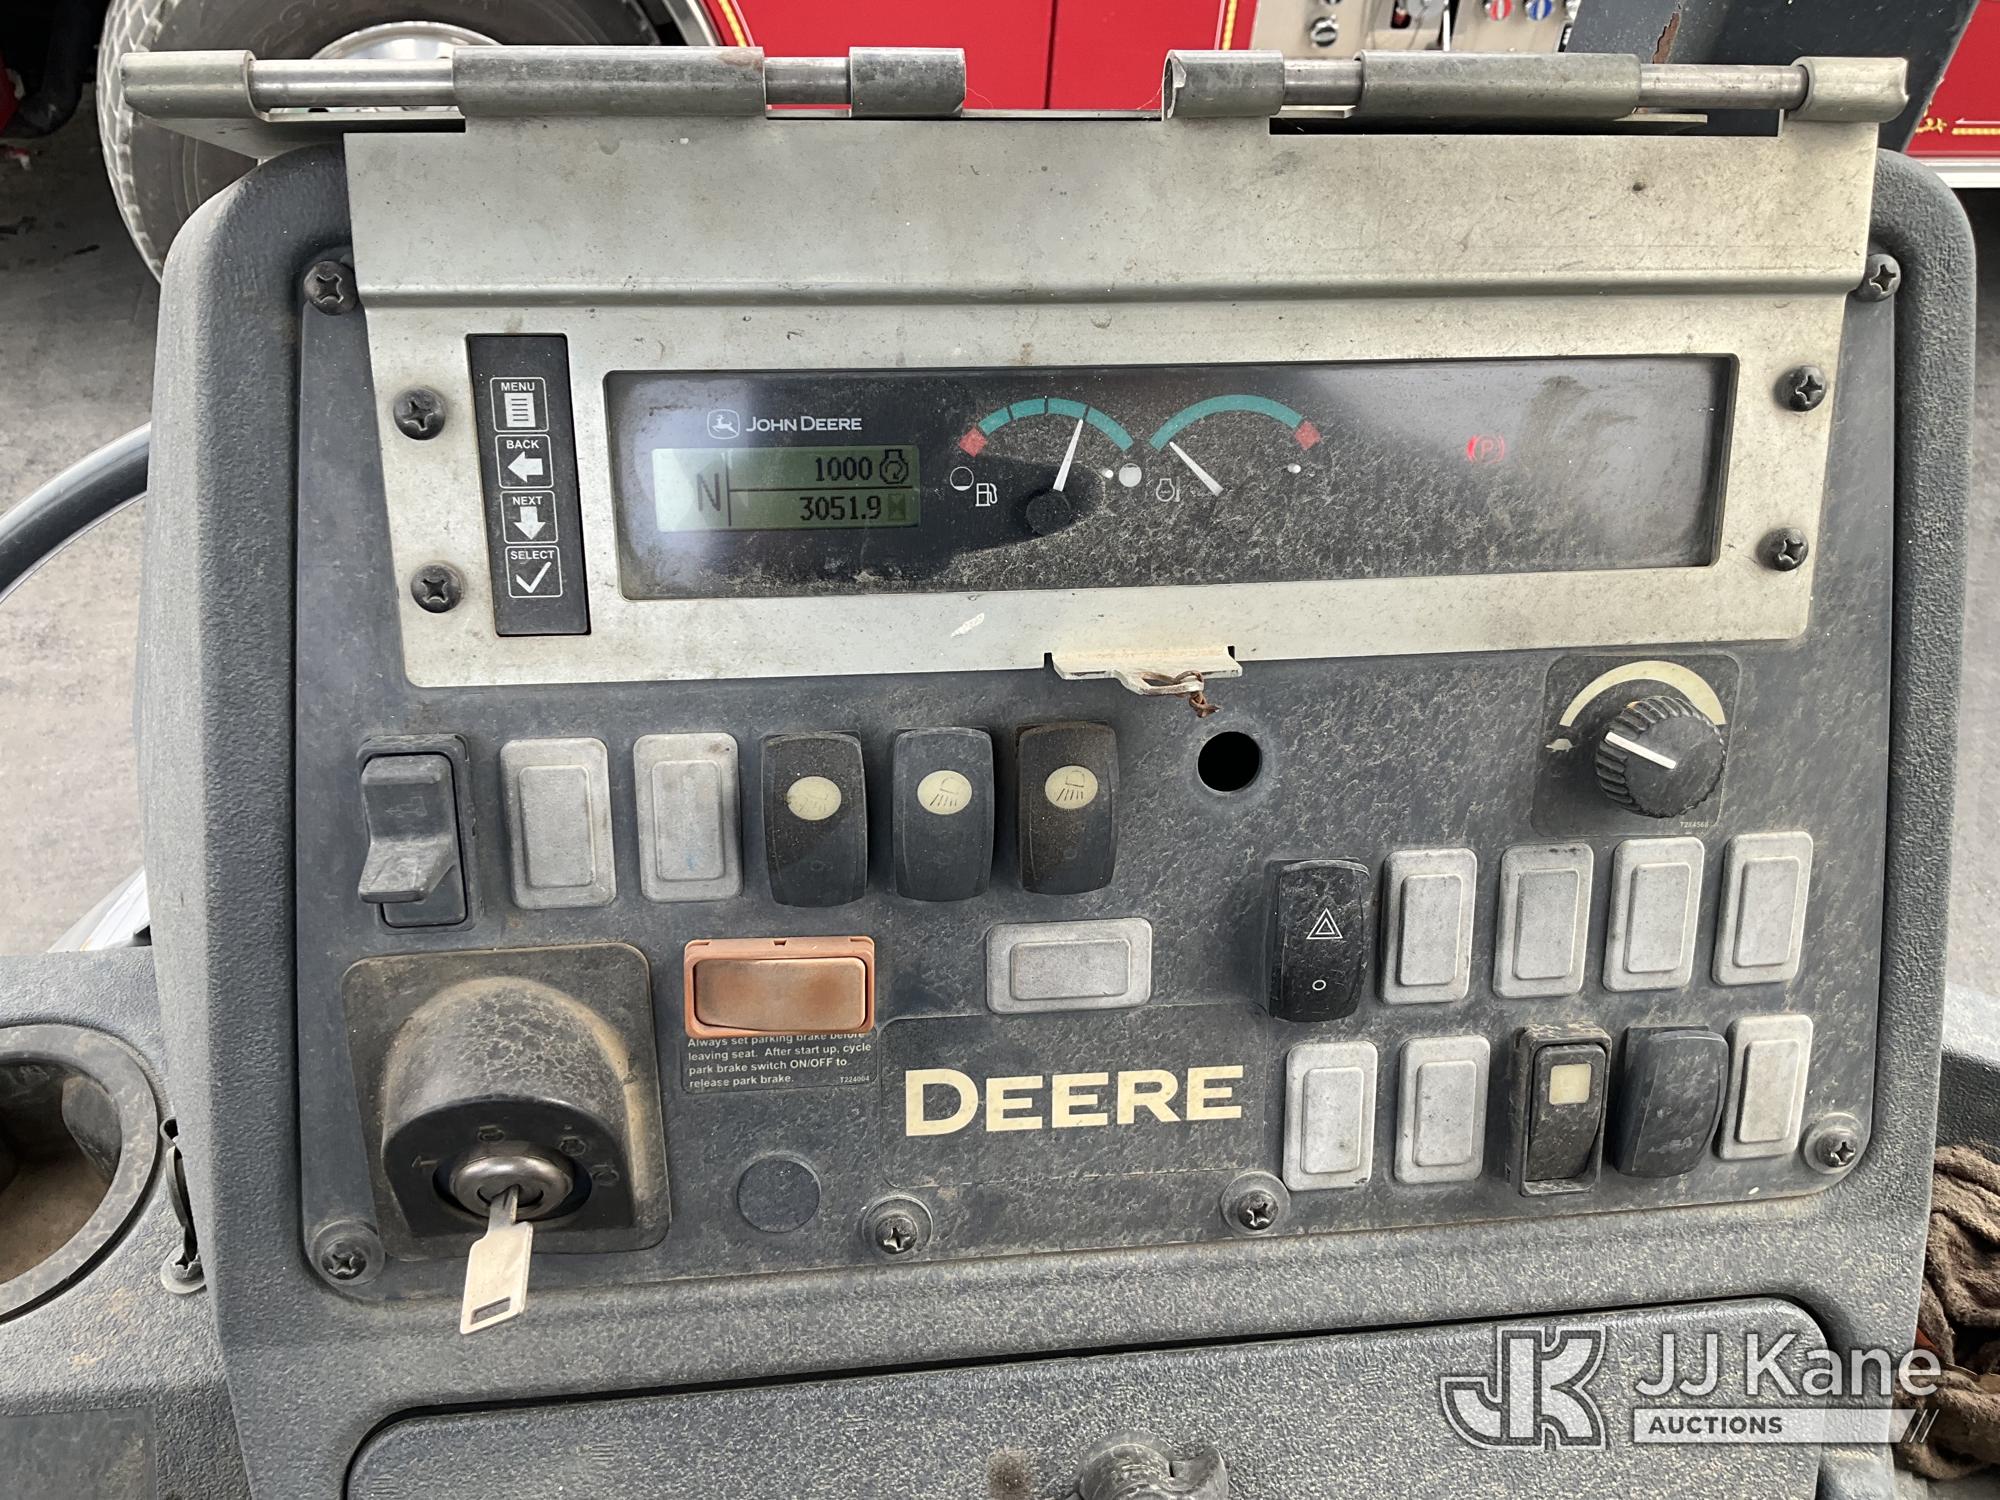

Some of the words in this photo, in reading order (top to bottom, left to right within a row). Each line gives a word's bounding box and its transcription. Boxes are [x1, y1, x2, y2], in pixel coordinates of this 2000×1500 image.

[500, 381, 536, 392] MENU
[746, 416, 797, 432] JOHN
[800, 415, 863, 432] DEERE
[506, 439, 540, 449] BACK
[815, 456, 873, 482] 1000
[512, 495, 543, 506] NEXT
[696, 472, 721, 512] N
[799, 496, 882, 521] 3051.9
[510, 550, 555, 560] SELECT
[687, 1038, 728, 1048] Always
[731, 1036, 749, 1045] set
[688, 1051, 729, 1061] leaving
[731, 1049, 758, 1059] seat.
[764, 1047, 792, 1057] After
[794, 1045, 820, 1055] start
[822, 1045, 840, 1055] up,
[842, 1043, 872, 1054] cycle
[688, 1064, 713, 1077] park
[716, 1063, 748, 1073] brake
[751, 1061, 787, 1071] switch
[790, 1058, 833, 1069] ON/OFF
[836, 1058, 848, 1067] to
[689, 1079, 730, 1089] release
[732, 1075, 757, 1087] park
[760, 1074, 795, 1084] brake.
[905, 1065, 1244, 1137] DEERE
